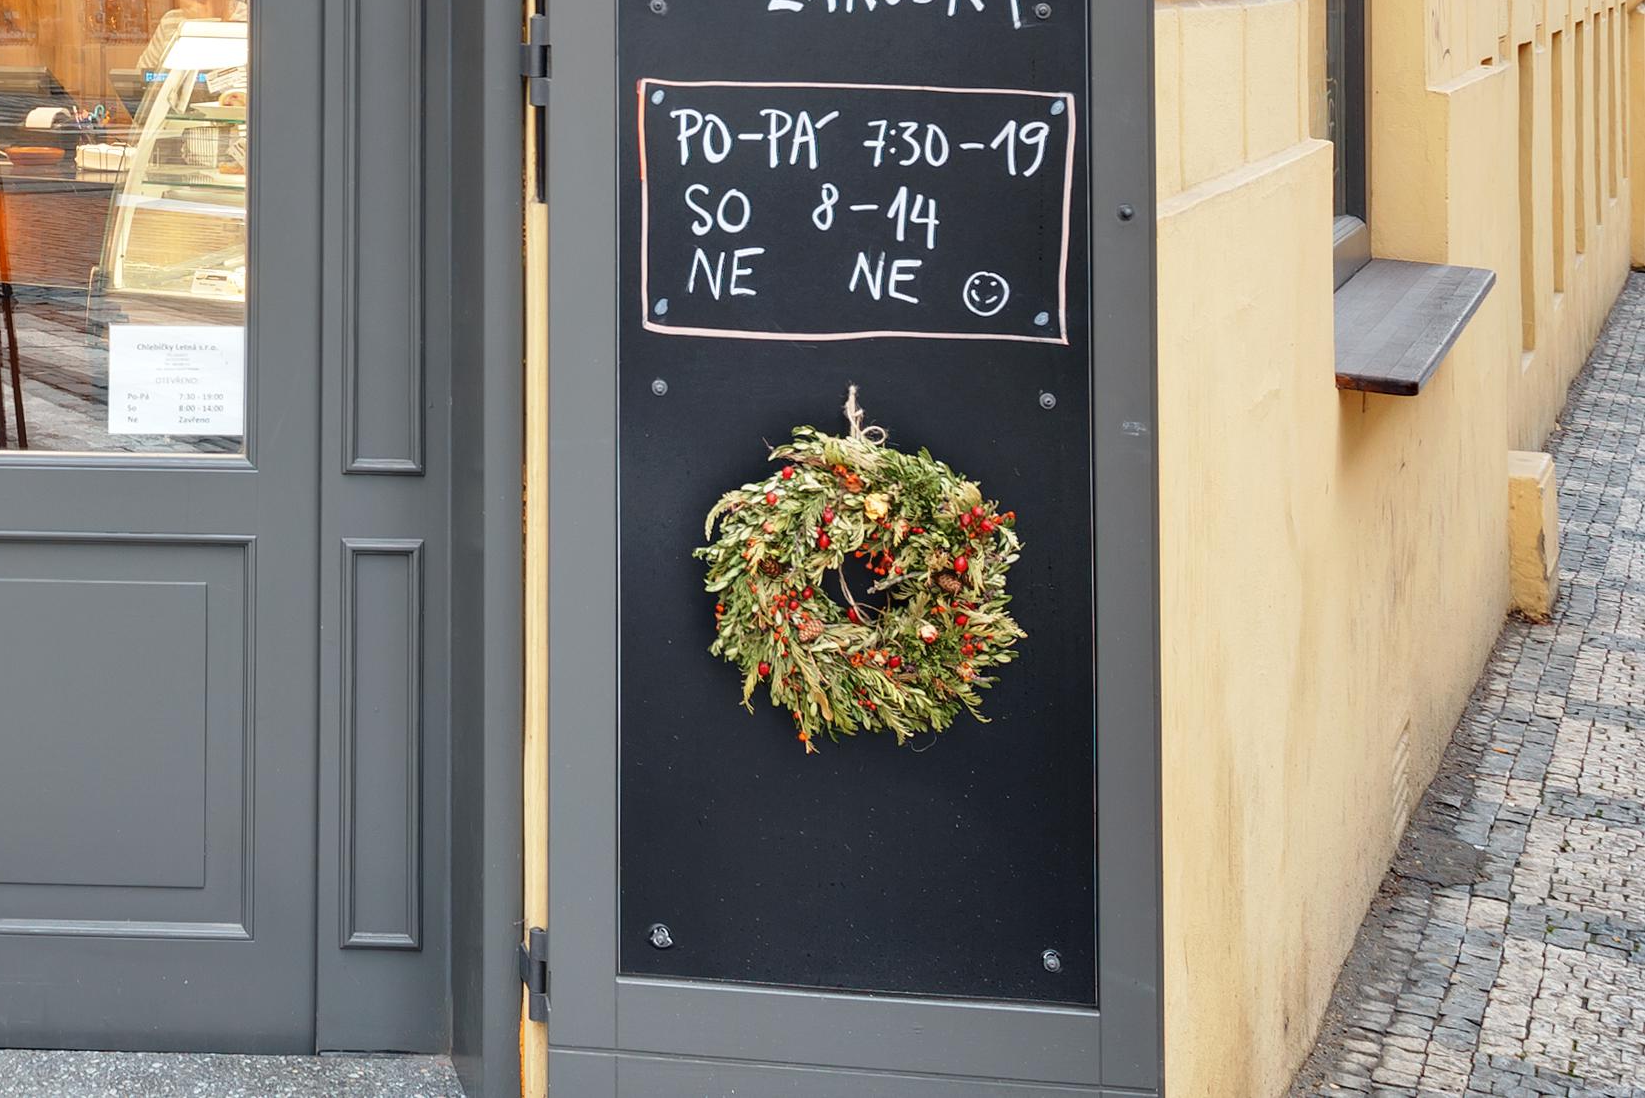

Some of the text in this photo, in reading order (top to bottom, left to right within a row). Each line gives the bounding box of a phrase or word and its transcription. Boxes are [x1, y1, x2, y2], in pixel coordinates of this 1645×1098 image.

[684, 183, 751, 236] SO
[687, 247, 923, 304] NE NE
